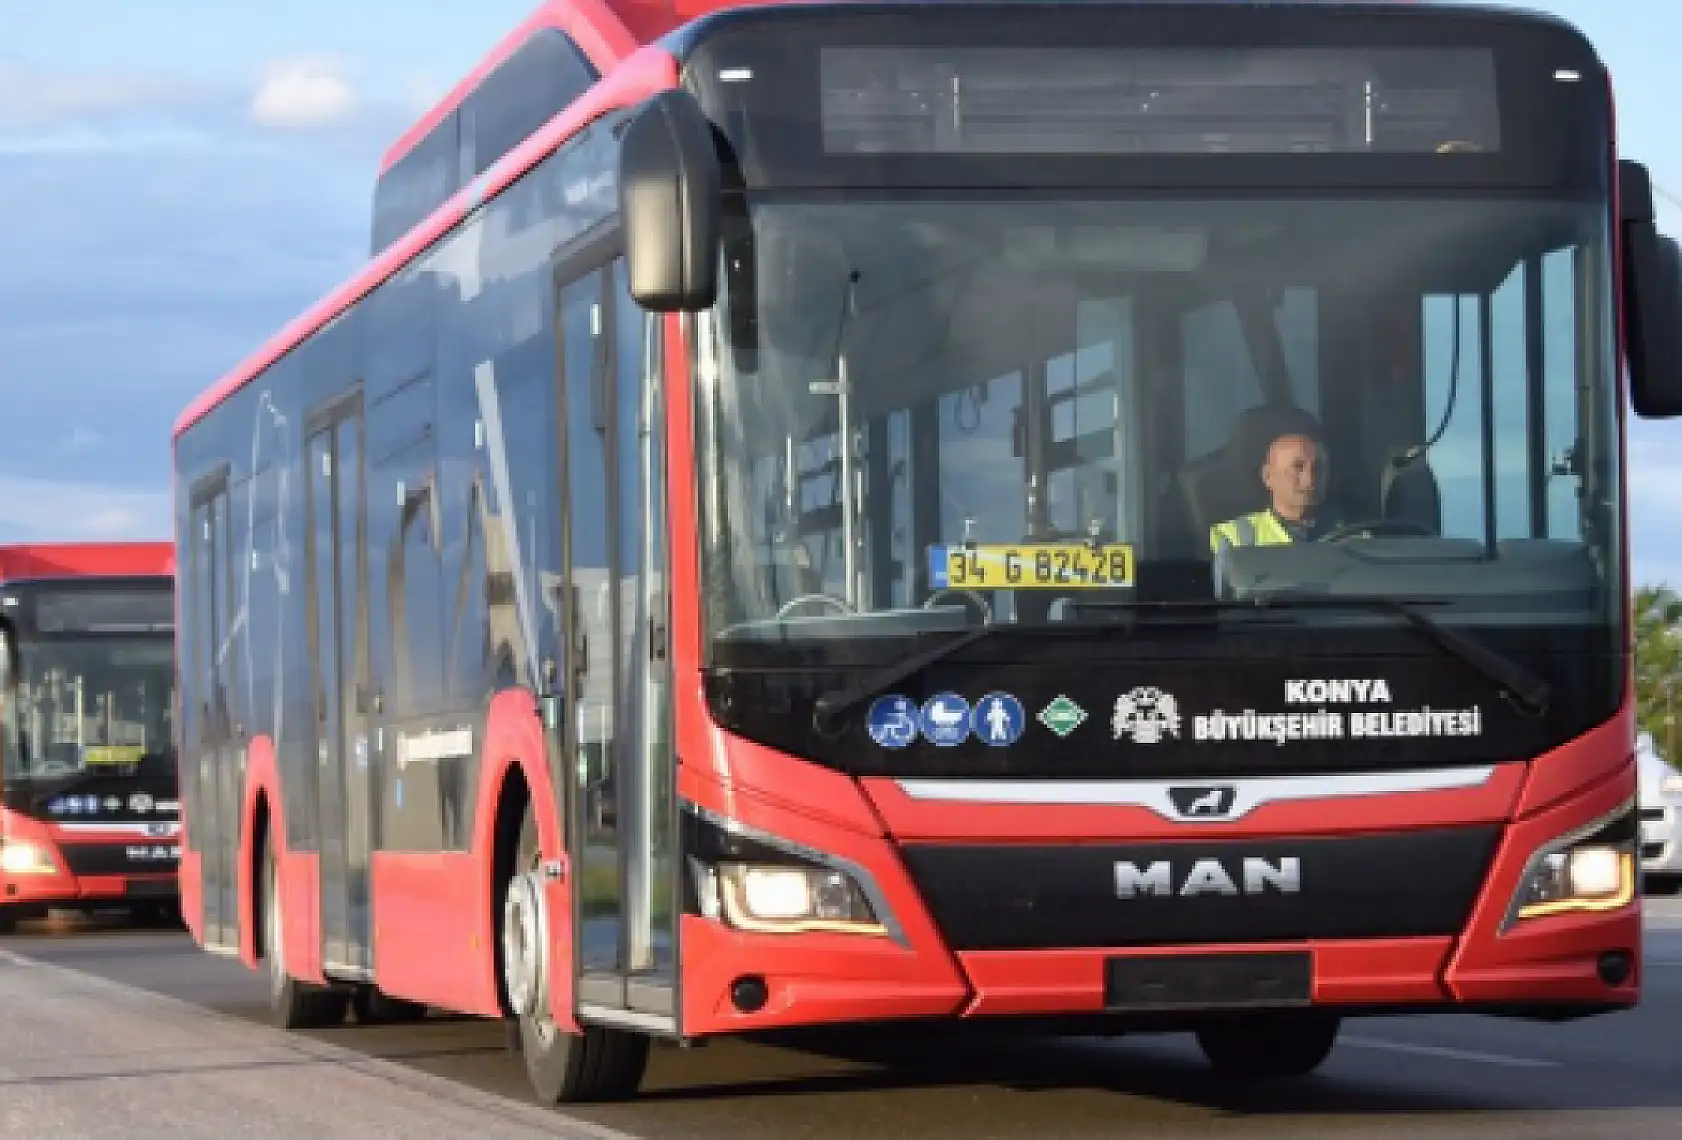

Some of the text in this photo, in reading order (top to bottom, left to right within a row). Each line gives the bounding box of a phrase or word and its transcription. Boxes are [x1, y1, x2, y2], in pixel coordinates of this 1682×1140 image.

[950, 549, 1127, 584] 34 G 82428
[1285, 679, 1392, 703] KONYA
[1193, 706, 1482, 746] BÜYÜKŞEHİR BELEDİYESİ
[1113, 856, 1301, 899] MAN
